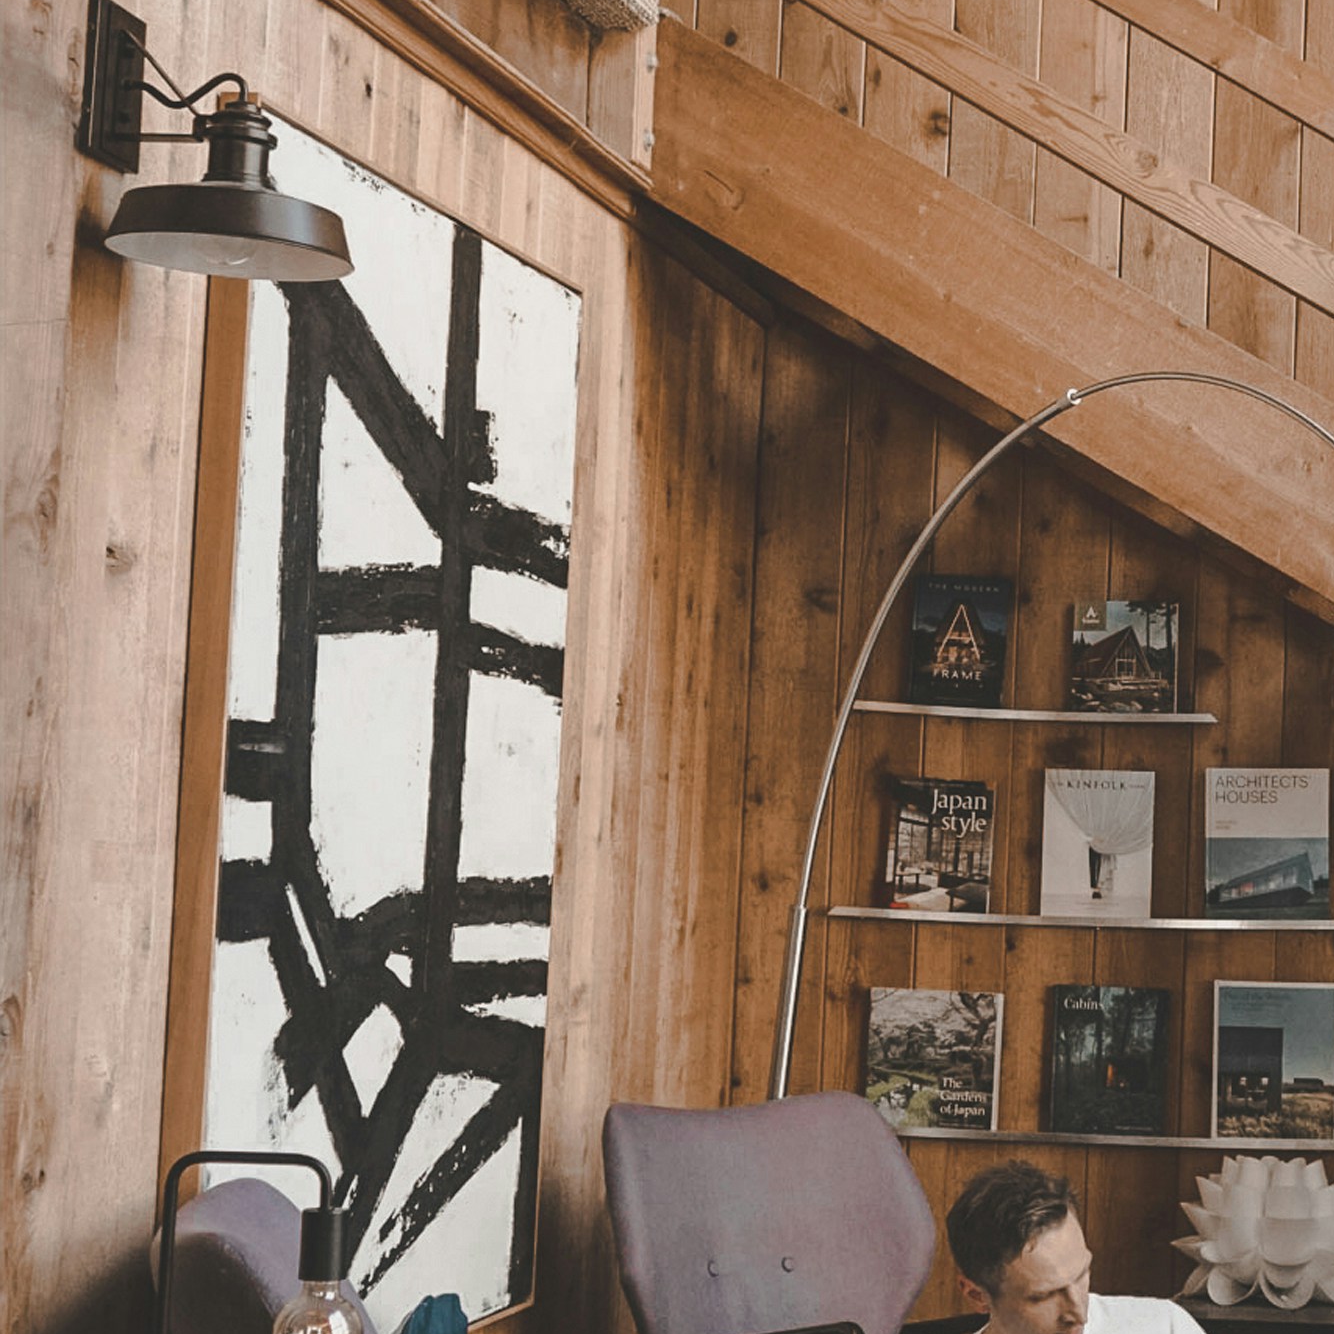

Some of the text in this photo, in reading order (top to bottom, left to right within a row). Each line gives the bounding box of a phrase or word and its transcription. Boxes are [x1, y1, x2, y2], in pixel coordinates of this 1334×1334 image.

[932, 668, 982, 681] FRAME
[1066, 780, 1125, 790] KINFOLK
[931, 788, 987, 815] Japan
[1215, 789, 1278, 804] HOUSES
[941, 811, 987, 838] style
[1064, 997, 1105, 1011] Cabins
[943, 1077, 963, 1089] The
[940, 1089, 987, 1103] Gardens
[940, 1103, 986, 1118] of Japan
